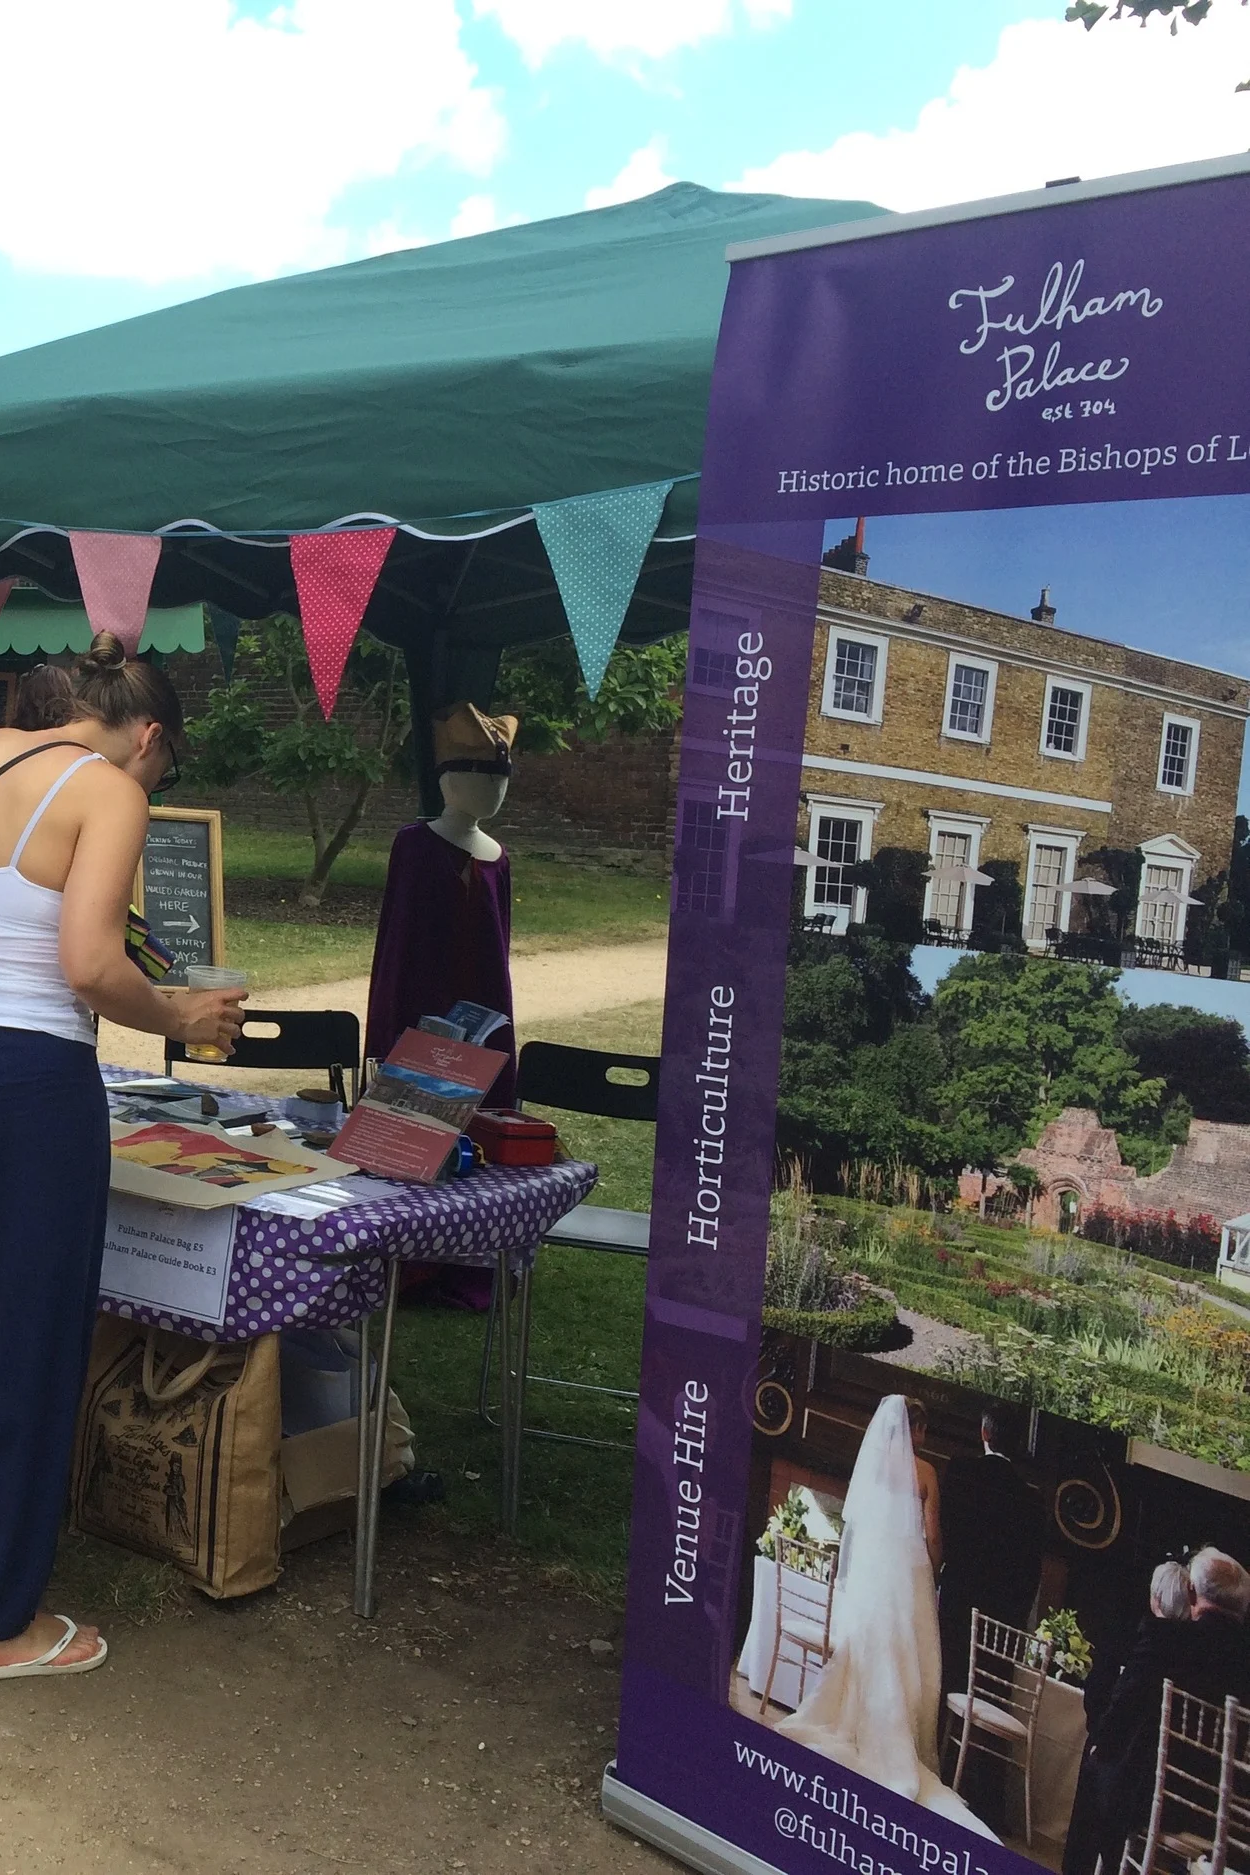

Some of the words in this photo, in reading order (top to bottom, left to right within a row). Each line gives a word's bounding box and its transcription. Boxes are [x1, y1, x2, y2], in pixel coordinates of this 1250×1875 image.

[948, 258, 1164, 355] Fulham
[985, 341, 1130, 412] Palace
[1041, 401, 1074, 423] est
[1079, 398, 1117, 418] 704
[777, 464, 880, 494] Historic
[884, 461, 964, 486] home
[971, 452, 1003, 481] of
[1006, 450, 1051, 478] the
[1057, 443, 1178, 476] Bishops
[1186, 434, 1222, 465] of
[716, 630, 773, 823] Heritage
[149, 868, 175, 878] GROWN
[187, 872, 203, 881] OUR
[173, 887, 207, 898] GARDEN
[159, 900, 190, 912] HERE
[175, 937, 206, 949] ENTRY
[687, 984, 735, 1251] Horticulture
[102, 1241, 129, 1255] ulham
[130, 1247, 158, 1261] Palace
[158, 1254, 182, 1268] Guide
[182, 1260, 205, 1273] Book
[205, 1266, 217, 1276] £3
[117, 1224, 149, 1239] Fulham
[149, 1231, 176, 1247] Palace
[176, 1238, 192, 1252] Bag
[192, 1242, 204, 1252] £5
[673, 1380, 709, 1473] Hire
[664, 1480, 702, 1605] Venue
